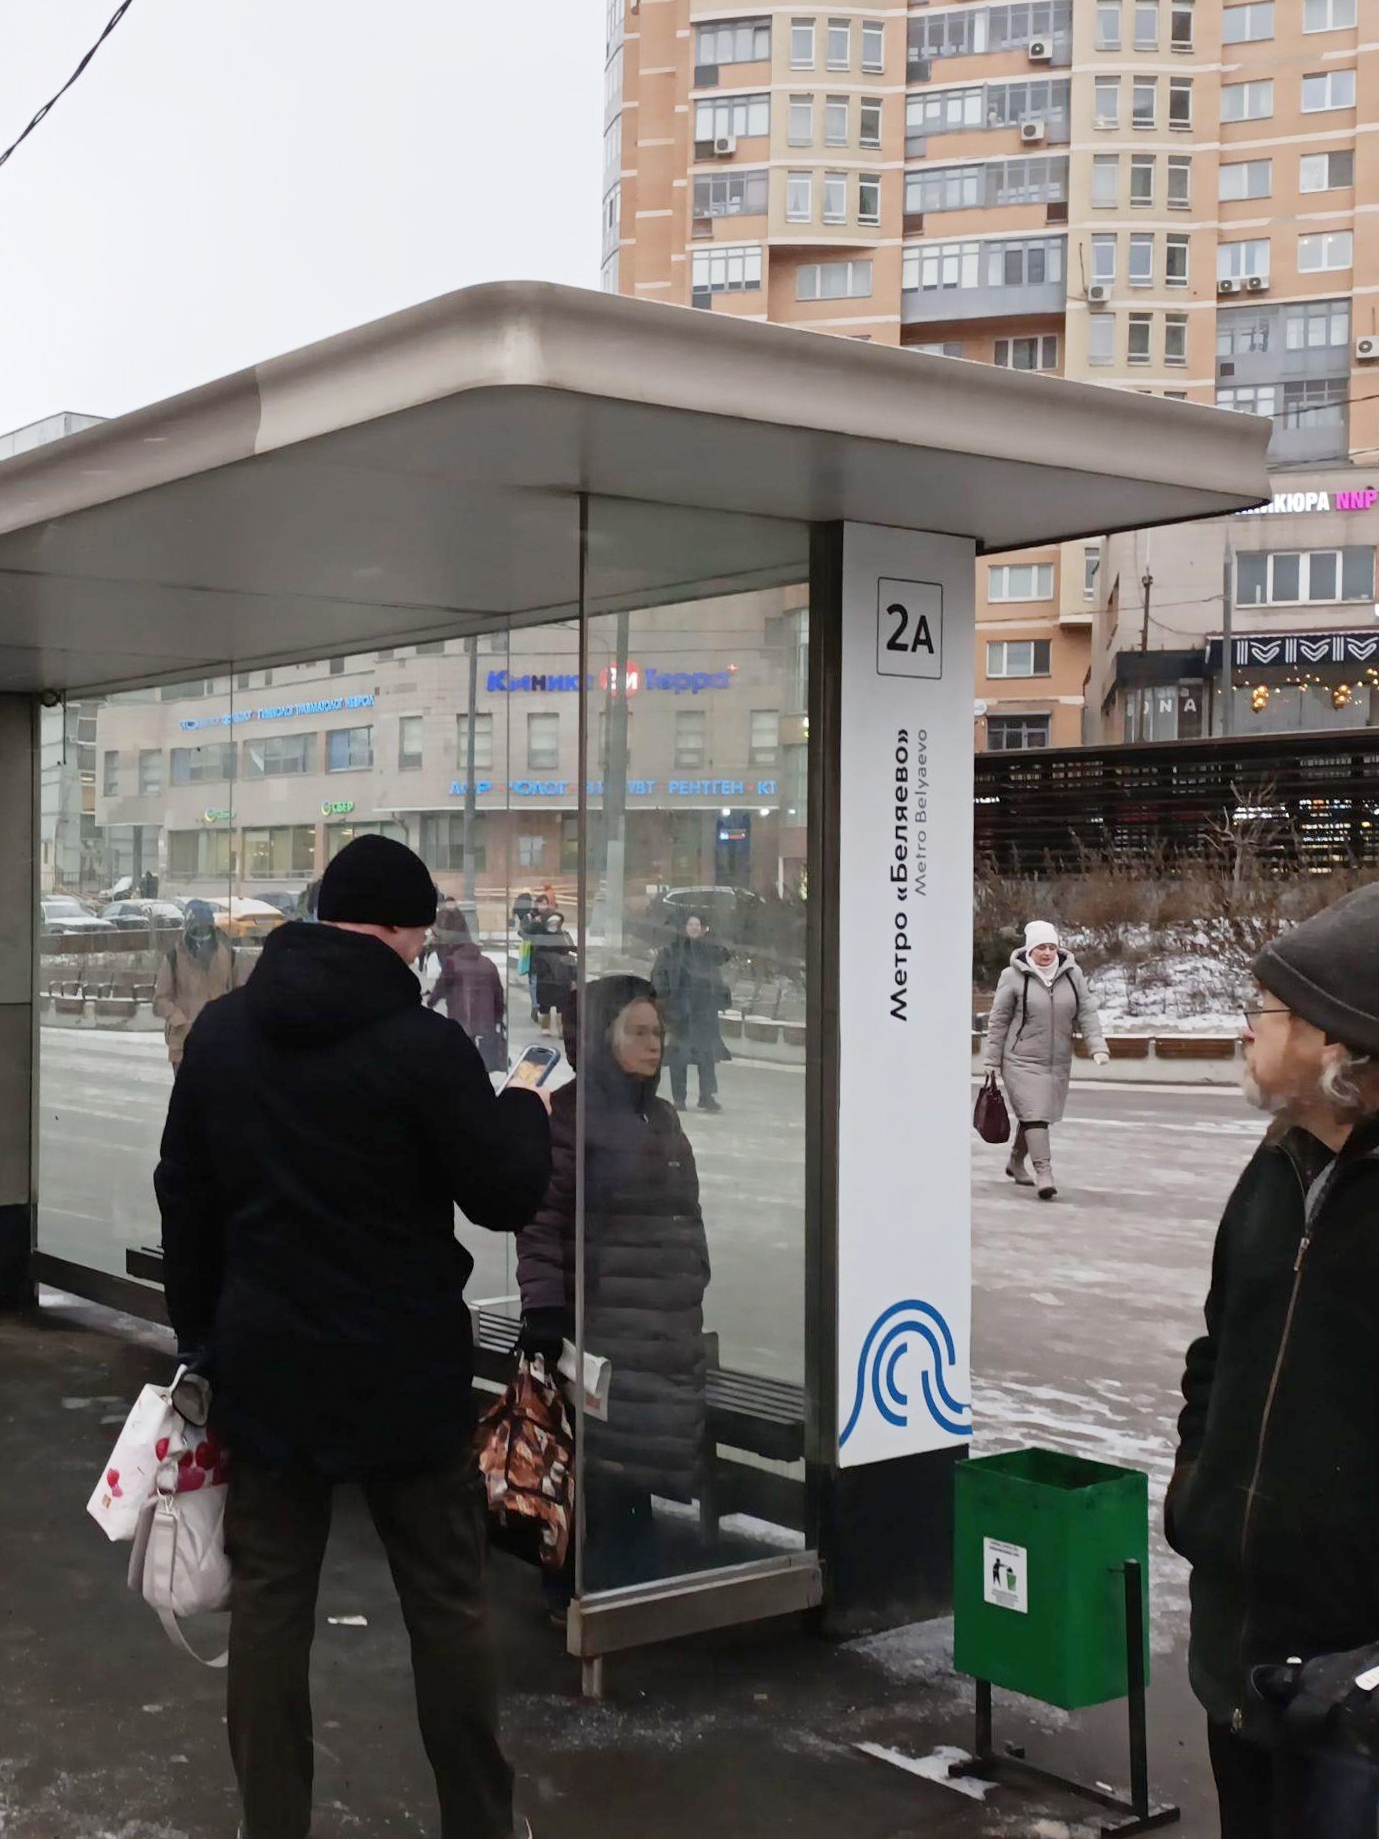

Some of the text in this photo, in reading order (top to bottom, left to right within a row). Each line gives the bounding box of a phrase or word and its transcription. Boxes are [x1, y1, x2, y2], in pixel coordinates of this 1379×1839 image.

[669, 780, 744, 795] РЕНТГЕН
[914, 729, 930, 896] Metro Belyaevo
[890, 728, 912, 1022] Метро «Беляево»
